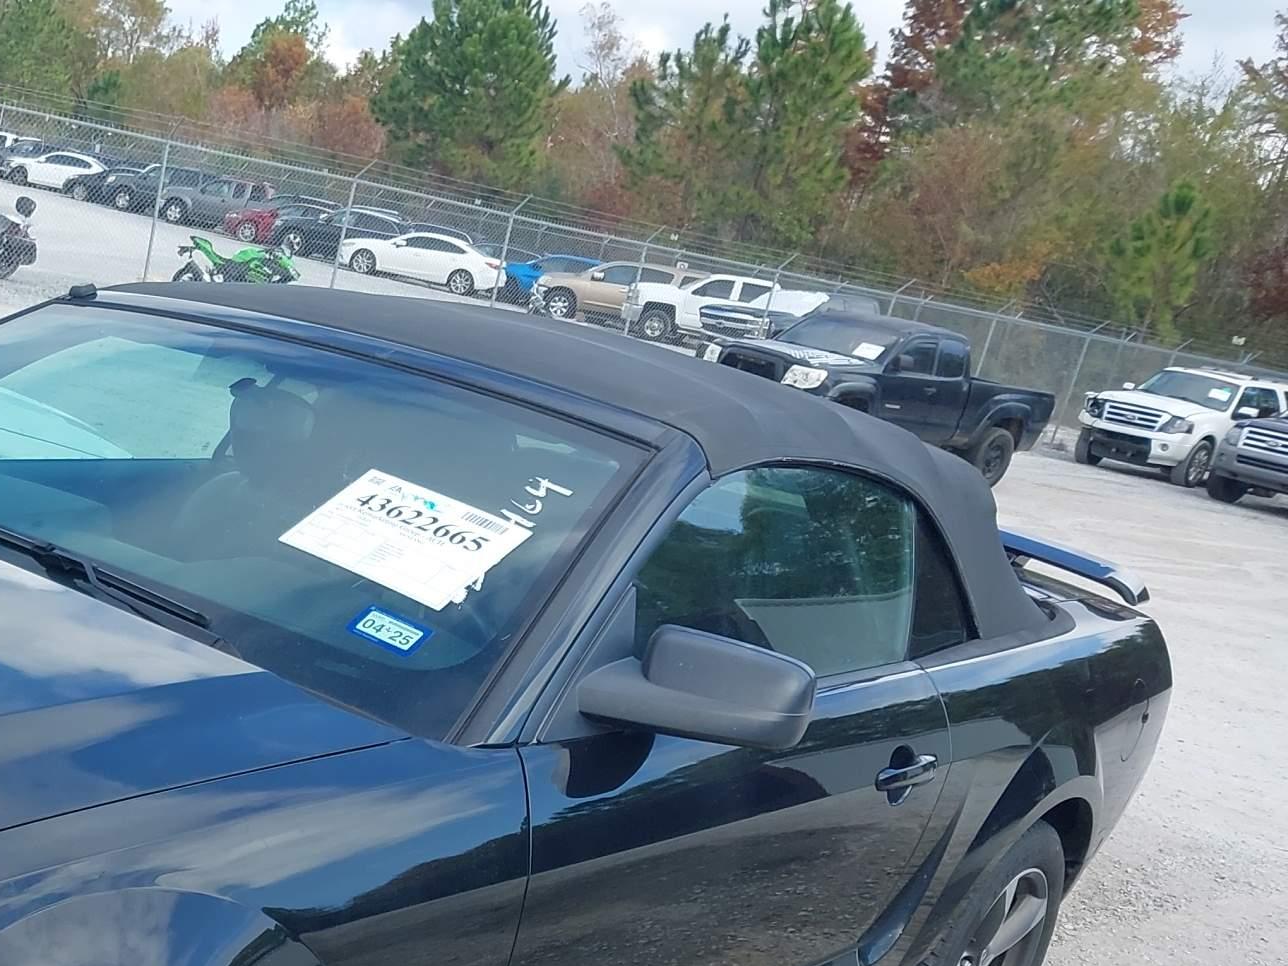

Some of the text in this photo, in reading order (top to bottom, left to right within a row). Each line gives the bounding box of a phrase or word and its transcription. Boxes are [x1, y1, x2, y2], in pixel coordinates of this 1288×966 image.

[355, 494, 492, 552] 43622665
[361, 618, 385, 633] 04
[388, 630, 414, 646] 25
